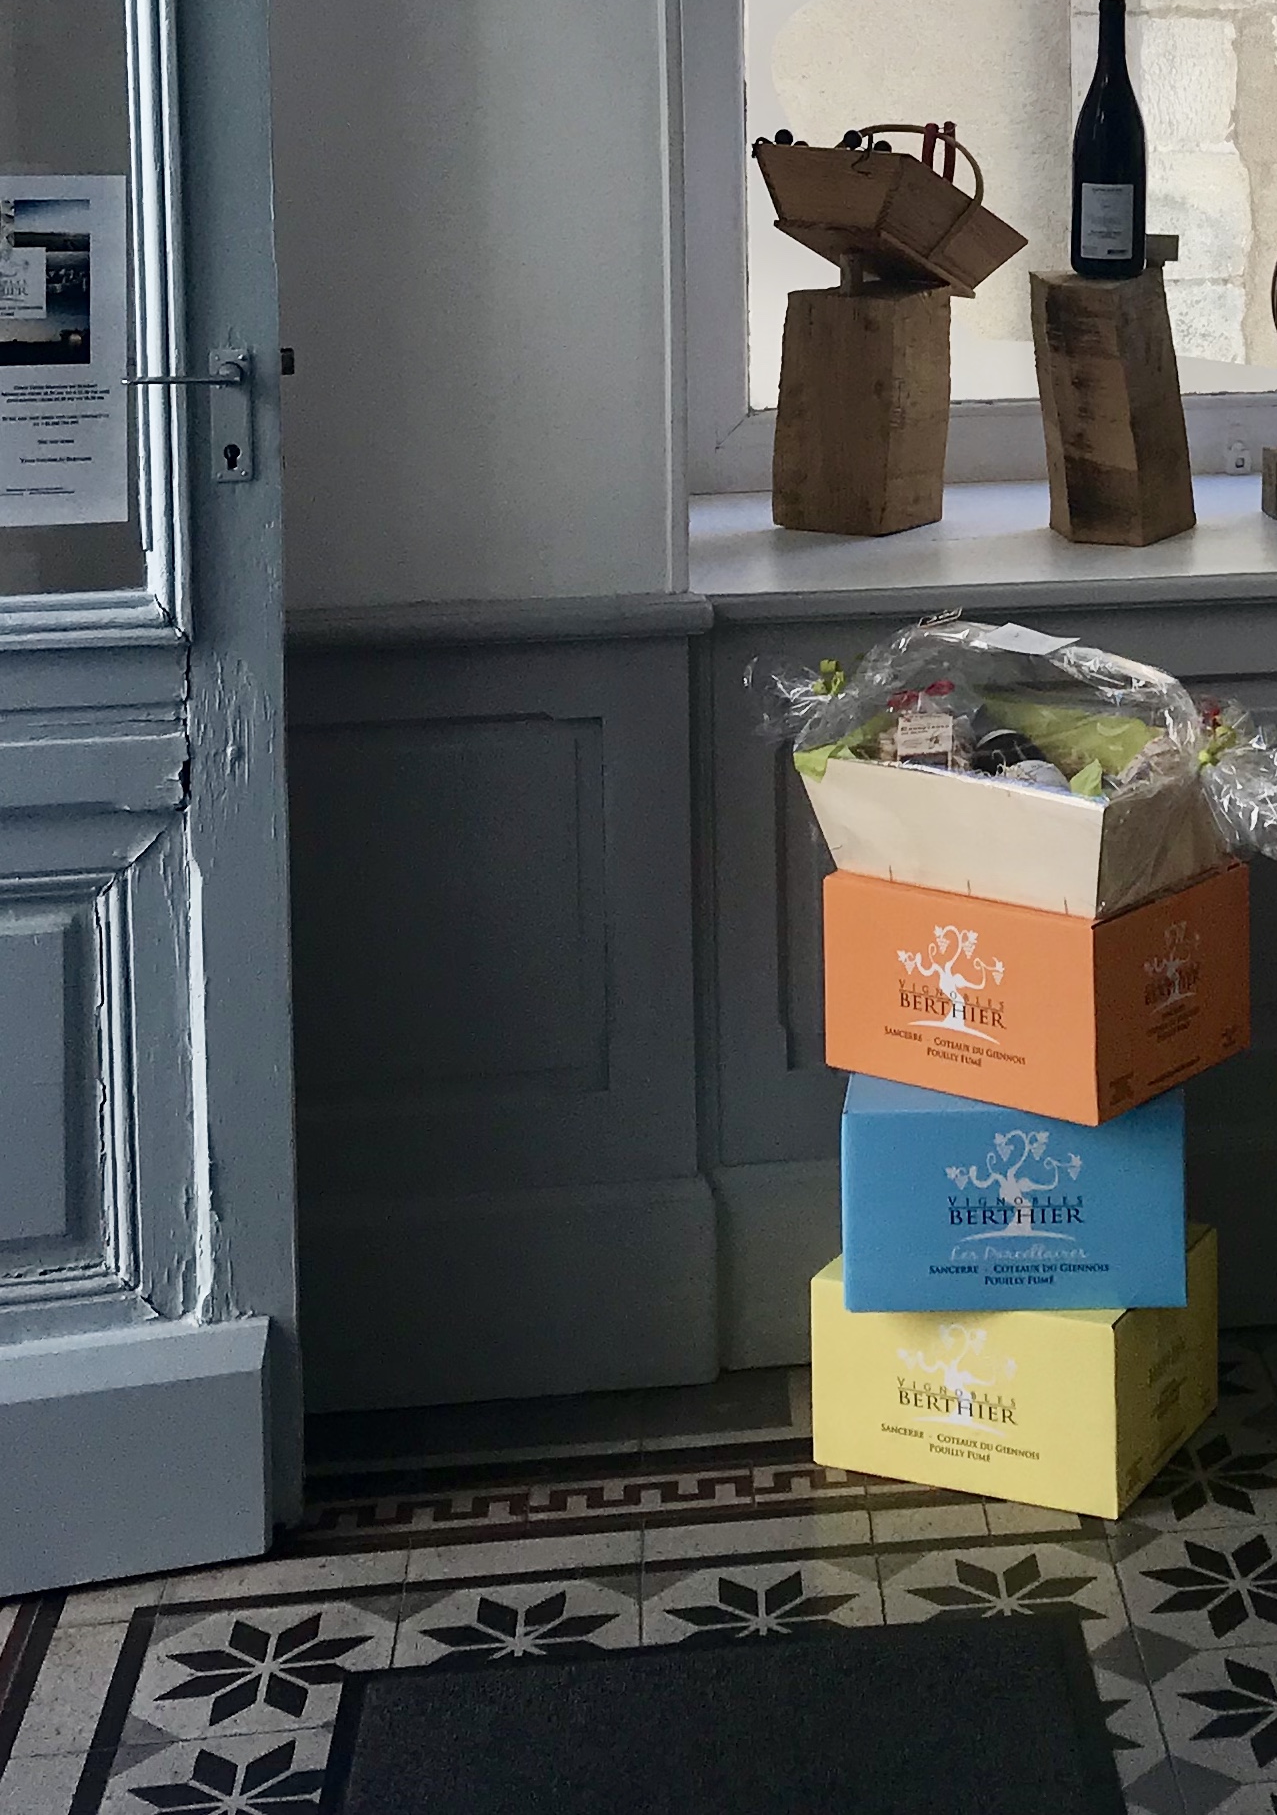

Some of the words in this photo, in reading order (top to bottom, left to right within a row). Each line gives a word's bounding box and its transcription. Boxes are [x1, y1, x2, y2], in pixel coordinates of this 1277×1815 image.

[899, 979, 1004, 1008] VIGNOBLES
[900, 992, 1007, 1029] BERTHIER
[948, 1196, 1083, 1206] VIGNOBLES
[949, 1208, 1084, 1225] BERTHIER
[897, 1376, 1016, 1407] VIGNOBLES
[899, 1390, 1018, 1425] BERTHIER
[881, 1423, 924, 1439] SANCERRE
[937, 1433, 978, 1448] COTEAUX
[980, 1441, 993, 1451] DU
[995, 1444, 1040, 1460] GIENNOIS
[930, 1444, 965, 1458] POUILLY
